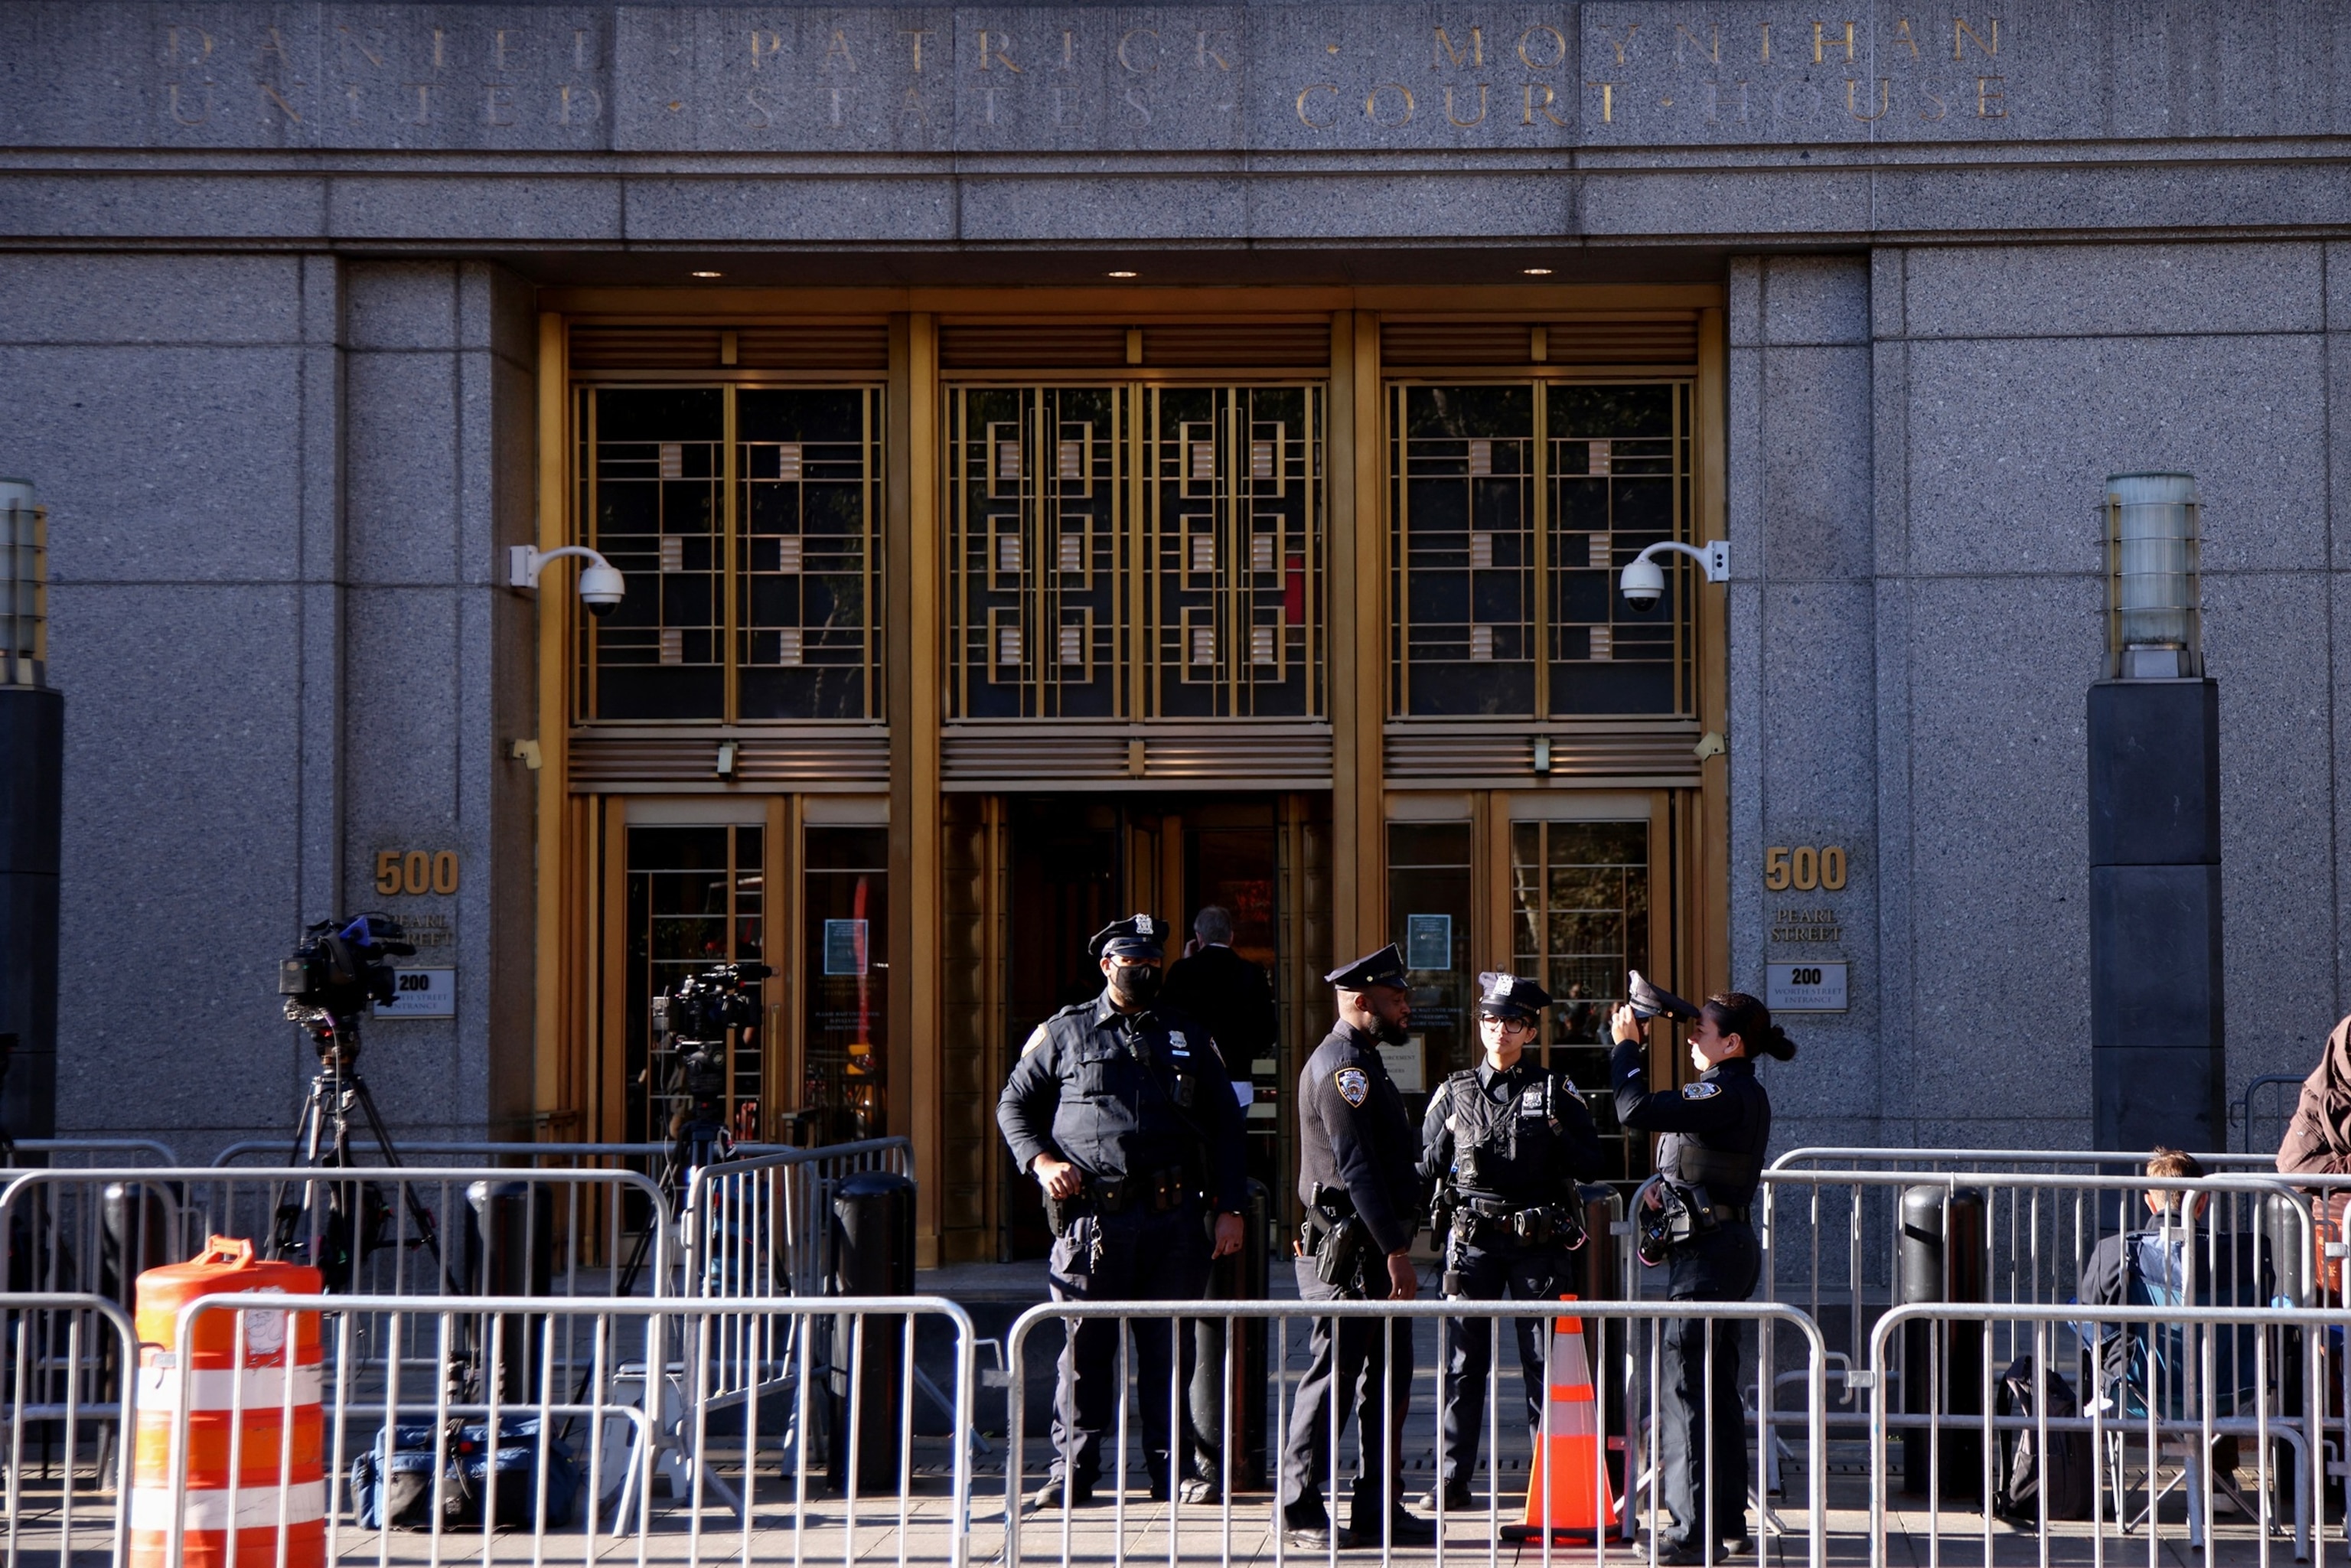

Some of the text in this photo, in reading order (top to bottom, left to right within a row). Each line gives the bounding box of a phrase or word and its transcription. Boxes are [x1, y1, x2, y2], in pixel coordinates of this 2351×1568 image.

[165, 17, 2000, 73] DANIEL PATRICK MOYNIHAN
[164, 75, 2010, 129] UNITED STATES COURT HOUSE
[377, 850, 458, 895] 500
[1766, 846, 1847, 891] 500
[1777, 909, 1836, 922] PEARL
[1772, 927, 1840, 940] STREET
[399, 975, 428, 990] 200
[1792, 968, 1821, 984] 200
